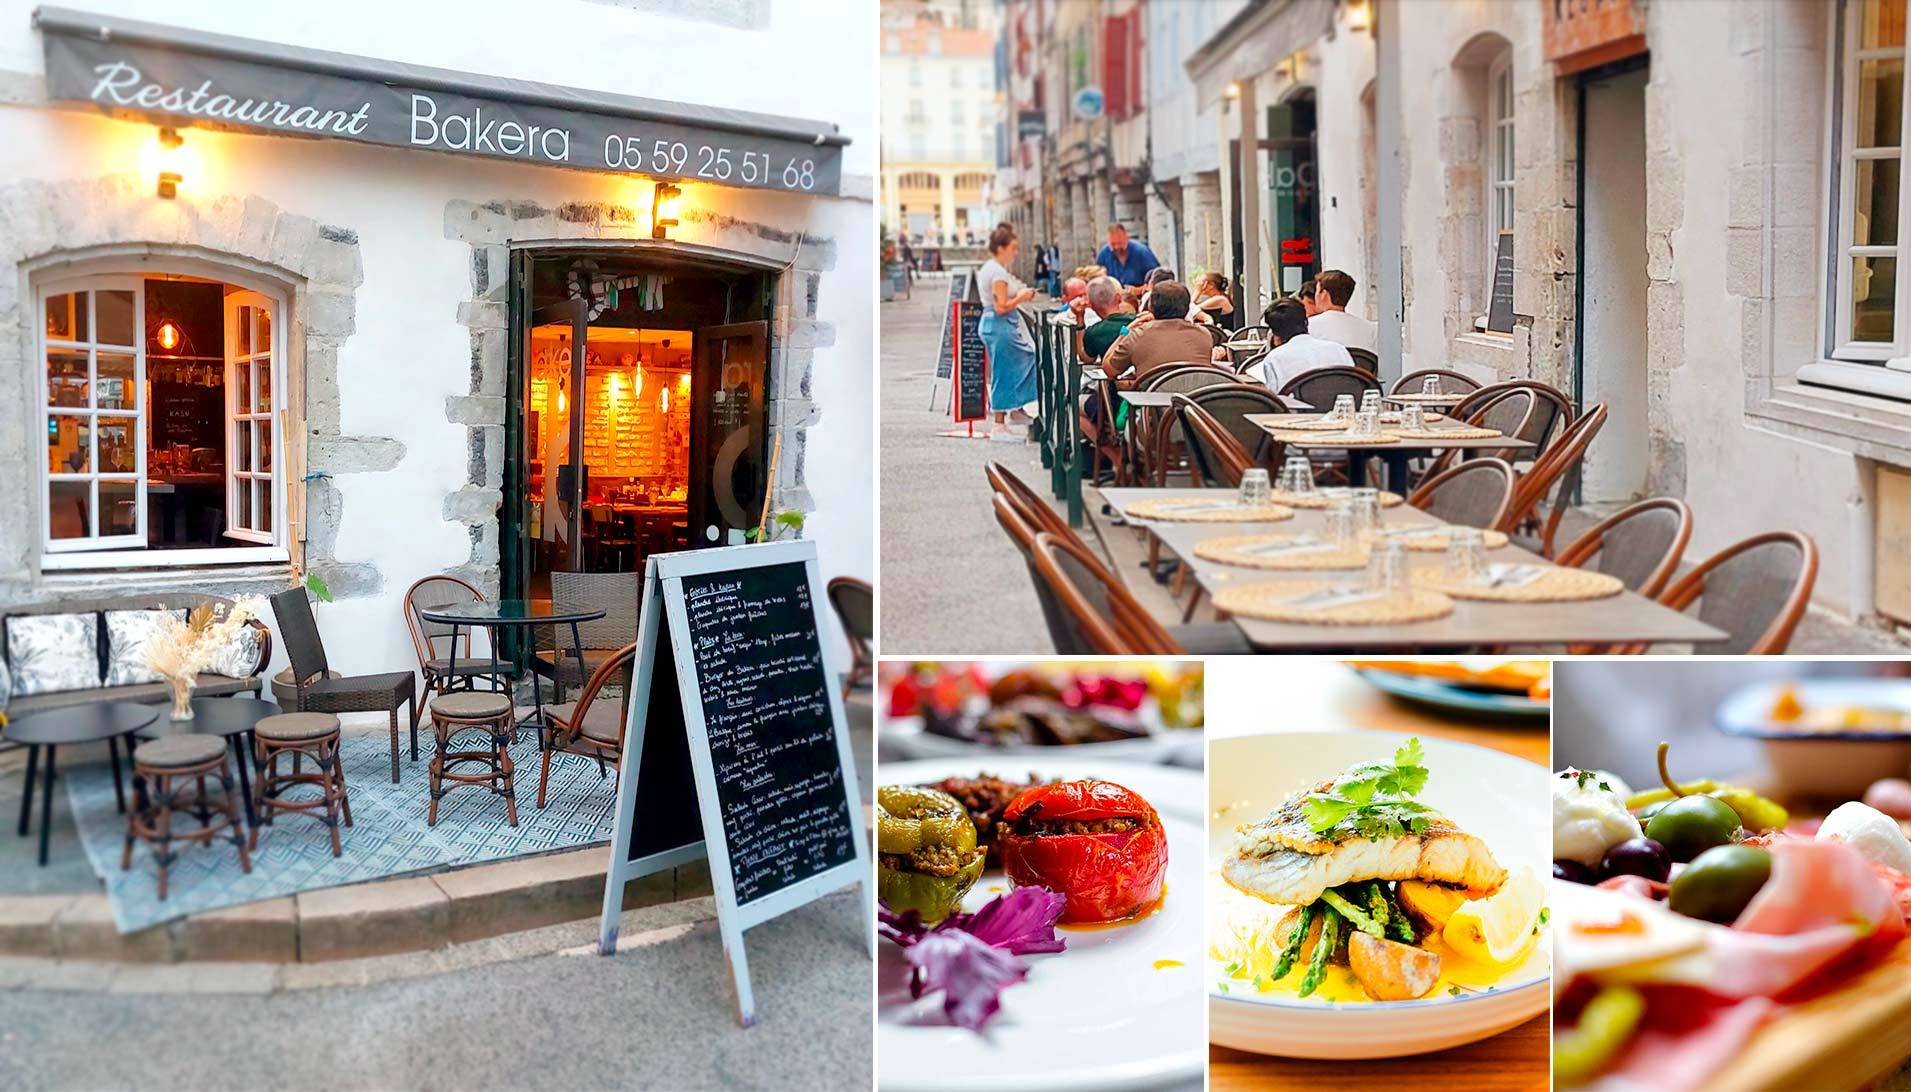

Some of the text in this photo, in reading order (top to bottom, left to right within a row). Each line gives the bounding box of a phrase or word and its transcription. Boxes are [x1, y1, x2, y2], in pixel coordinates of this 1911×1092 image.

[90, 60, 816, 190] Restaurant Bakera 05 59 25 51 68
